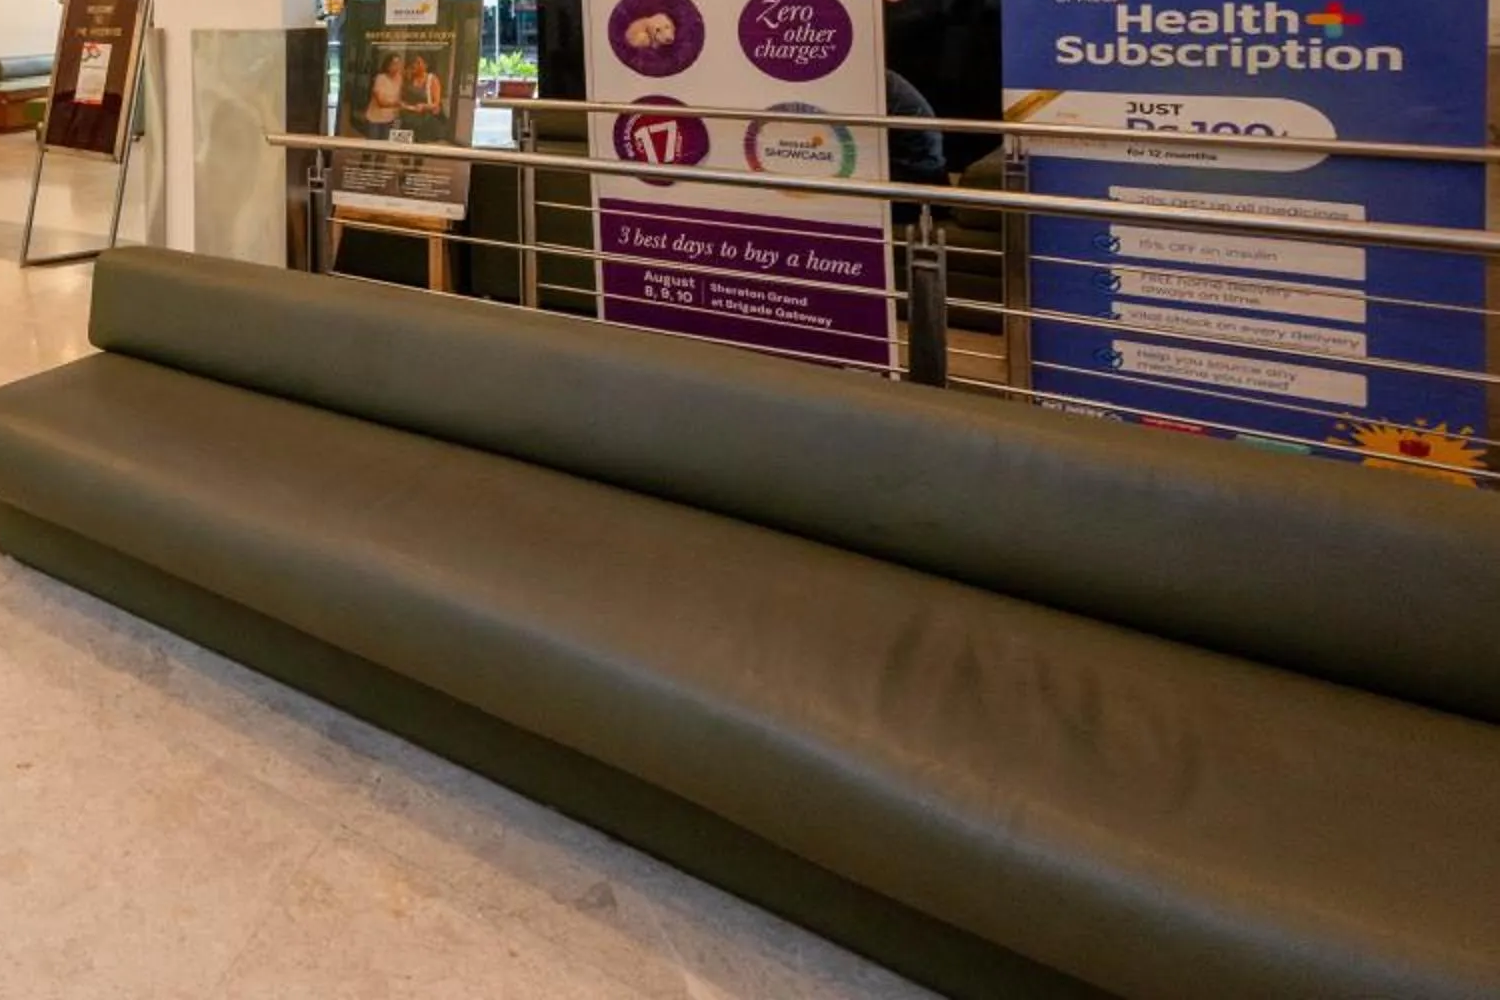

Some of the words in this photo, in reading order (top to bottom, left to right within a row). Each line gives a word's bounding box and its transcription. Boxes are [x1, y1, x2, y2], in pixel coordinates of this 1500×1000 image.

[783, 22, 837, 43] other
[1055, 34, 1403, 75] Subscription
[1125, 101, 1185, 116] JUST
[618, 226, 630, 245] 3
[633, 227, 667, 249] best
[672, 233, 714, 259] days
[719, 240, 738, 259] to
[743, 241, 780, 269] buy
[786, 253, 800, 268] a
[806, 250, 863, 277] home
[644, 270, 696, 290] August
[677, 290, 693, 304] 10
[708, 282, 766, 302] Sheraton
[767, 292, 809, 308] Grand
[725, 299, 773, 319] Brigade
[775, 306, 833, 328] Gateway
